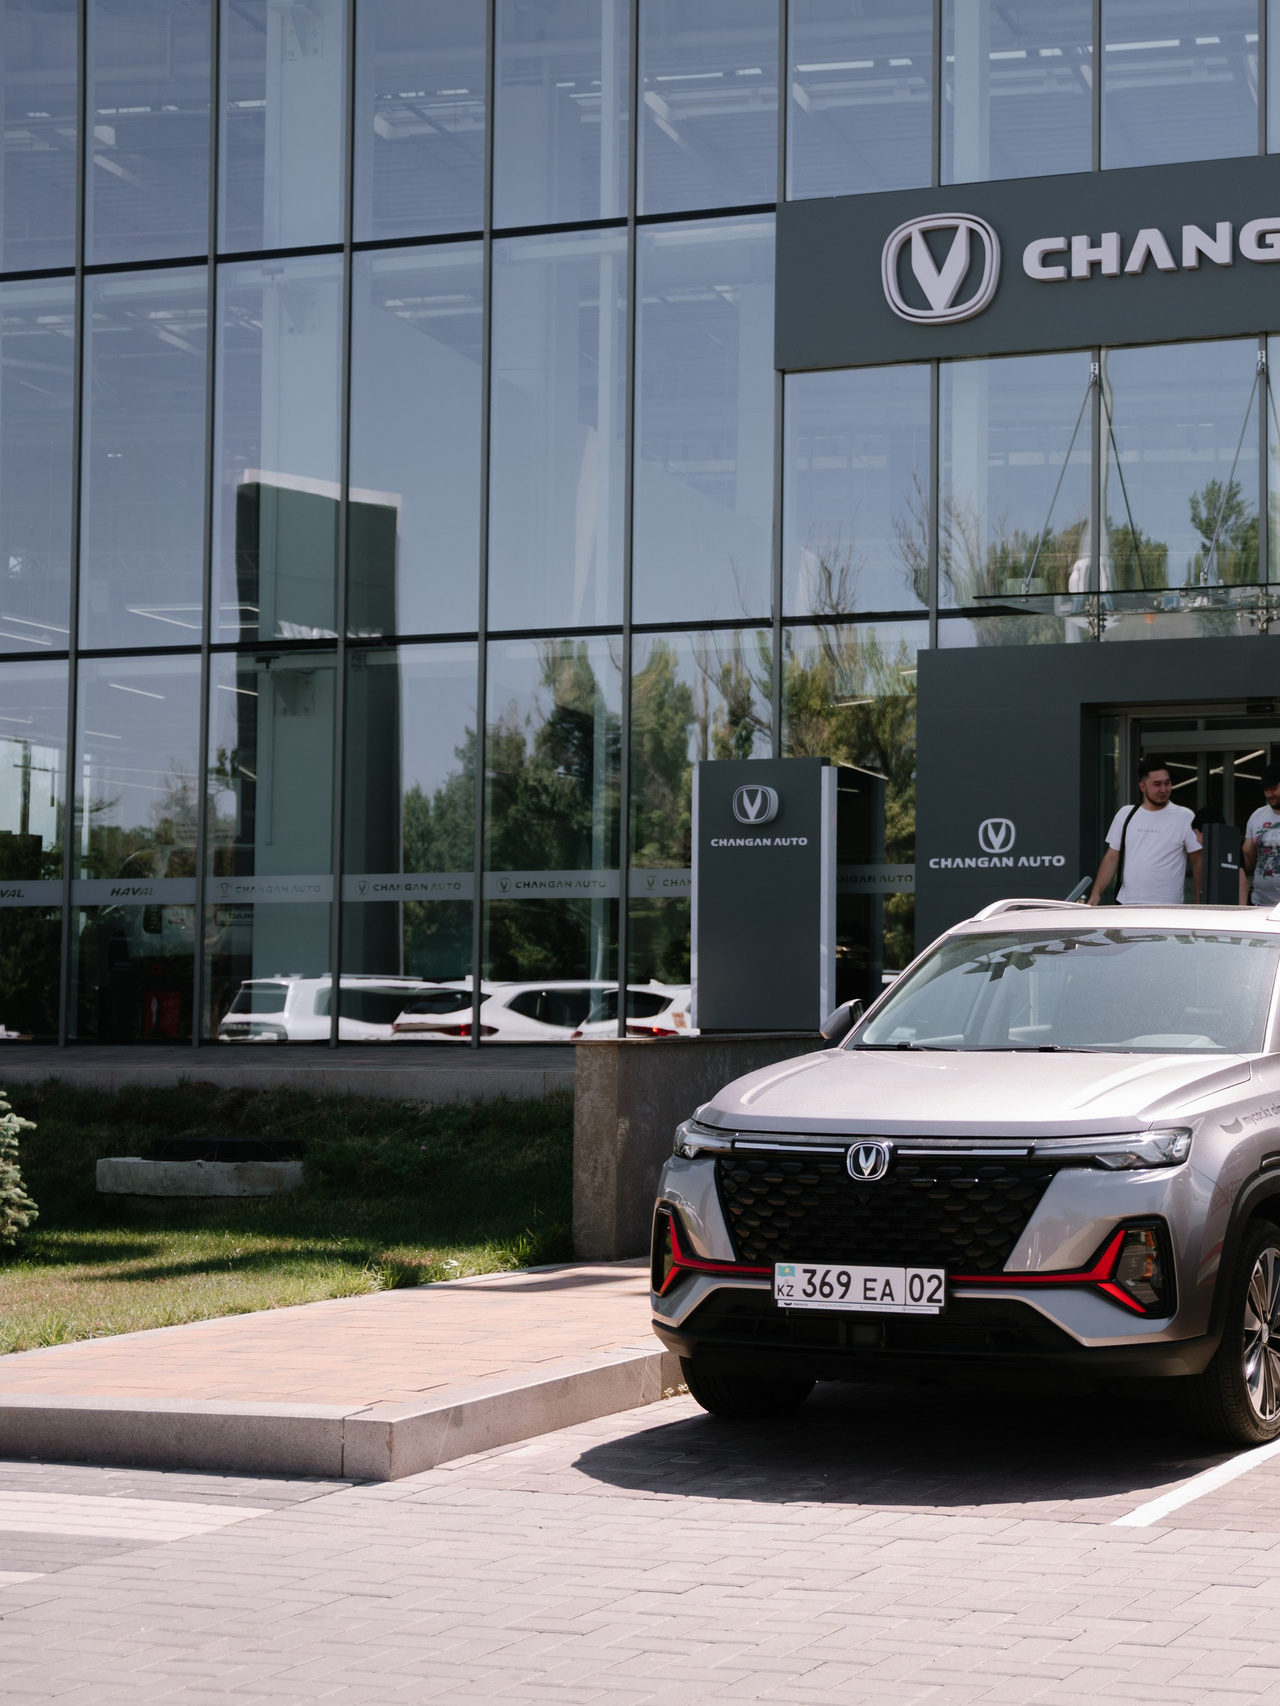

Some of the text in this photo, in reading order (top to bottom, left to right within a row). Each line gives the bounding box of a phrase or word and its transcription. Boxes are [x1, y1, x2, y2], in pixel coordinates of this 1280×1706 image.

[710, 837, 809, 847] CHANGAN AUTO
[928, 855, 1066, 869] CHANGAN AUTO
[880, 874, 913, 883] AUTO
[236, 885, 321, 894] CHANGAN AUTO
[372, 882, 462, 892] CHANGAN AUTO
[515, 880, 607, 889] CHANGAN AUTO
[110, 887, 156, 896] HAVAL
[1241, 1106, 1273, 1126] mycar.kz
[776, 1269, 944, 1304] KZ 369 EA 02
